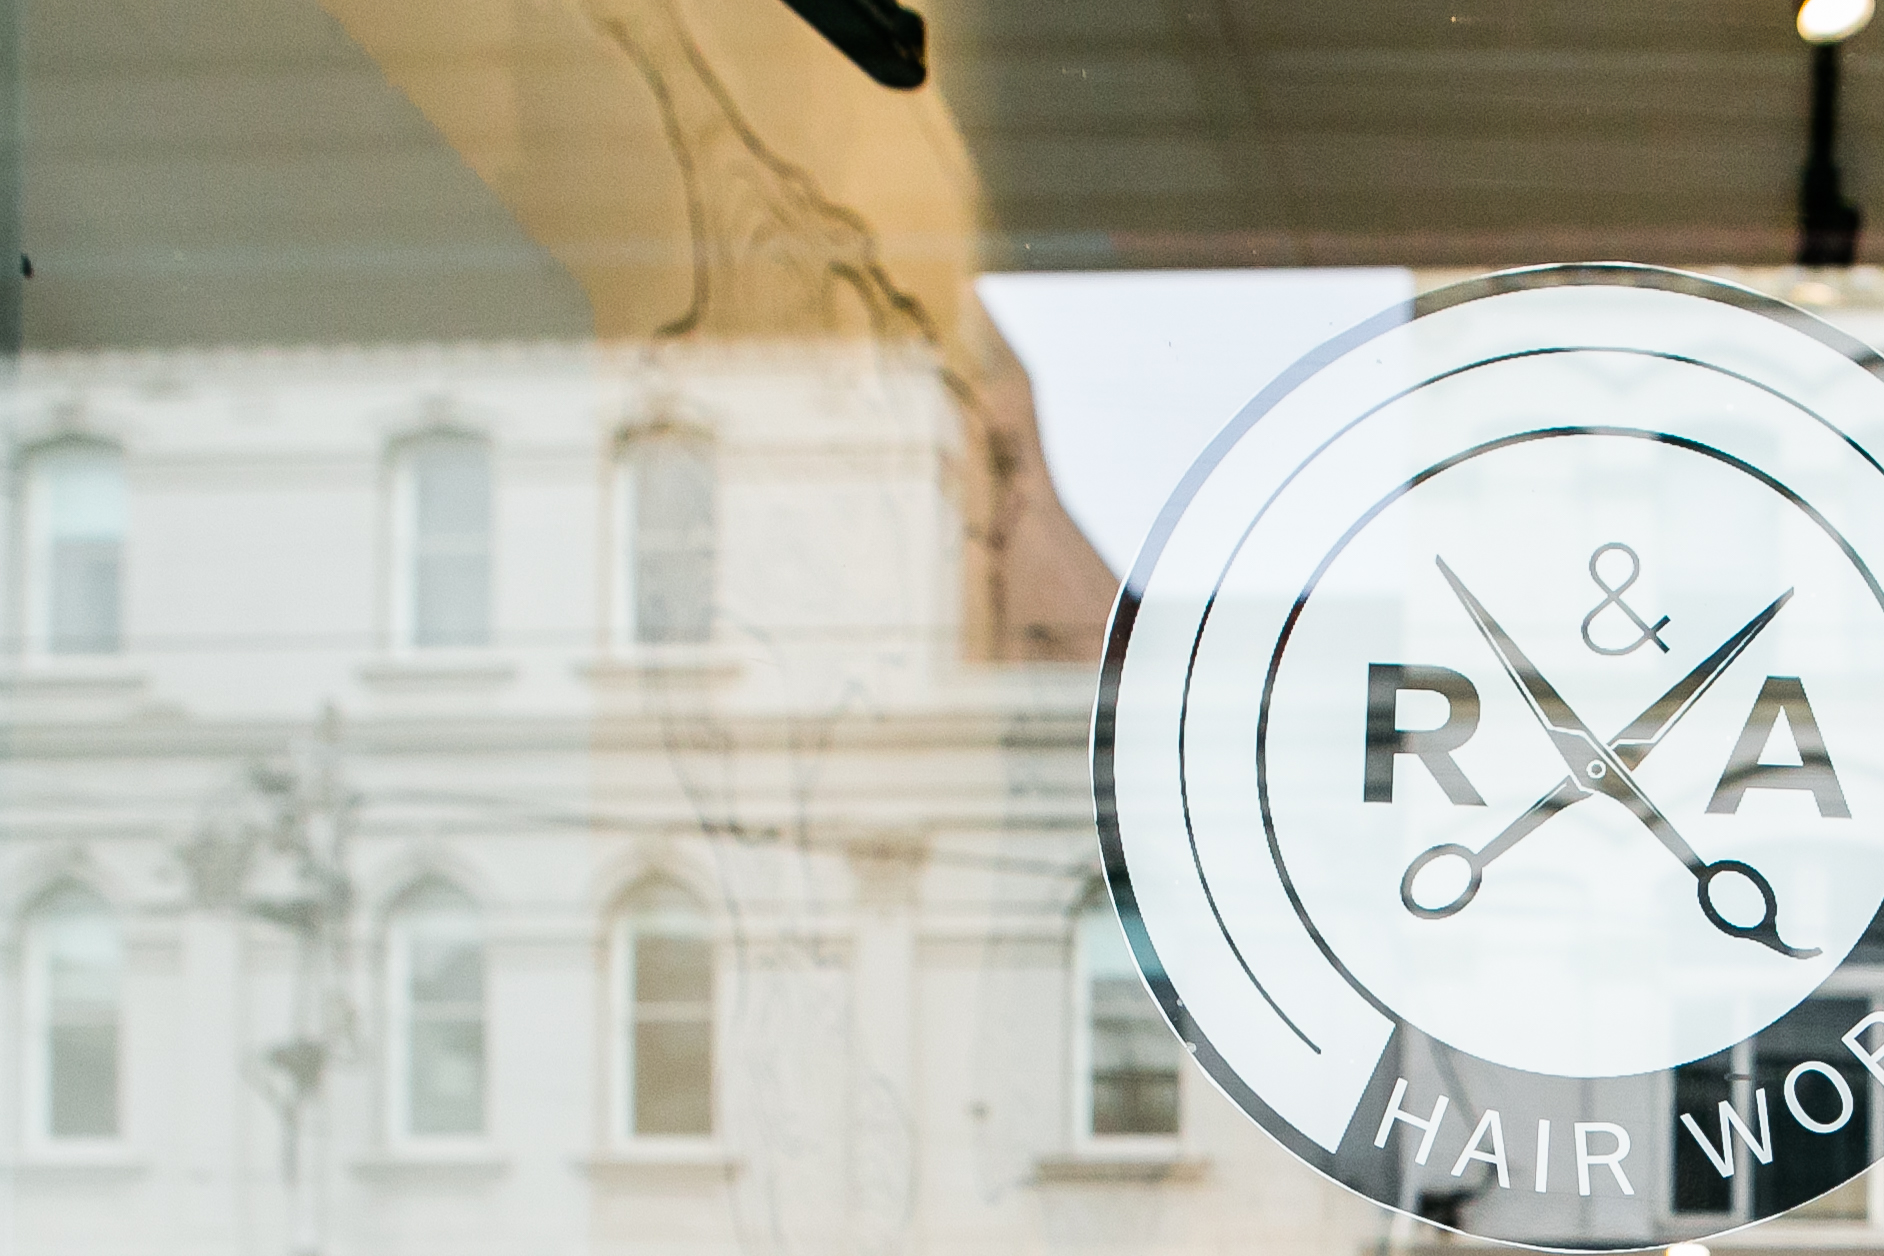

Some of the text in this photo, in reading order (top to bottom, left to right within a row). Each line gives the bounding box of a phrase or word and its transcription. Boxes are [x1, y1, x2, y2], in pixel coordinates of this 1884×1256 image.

[1363, 542, 1852, 818] R & A
[1373, 1078, 1635, 1197] HAIR
